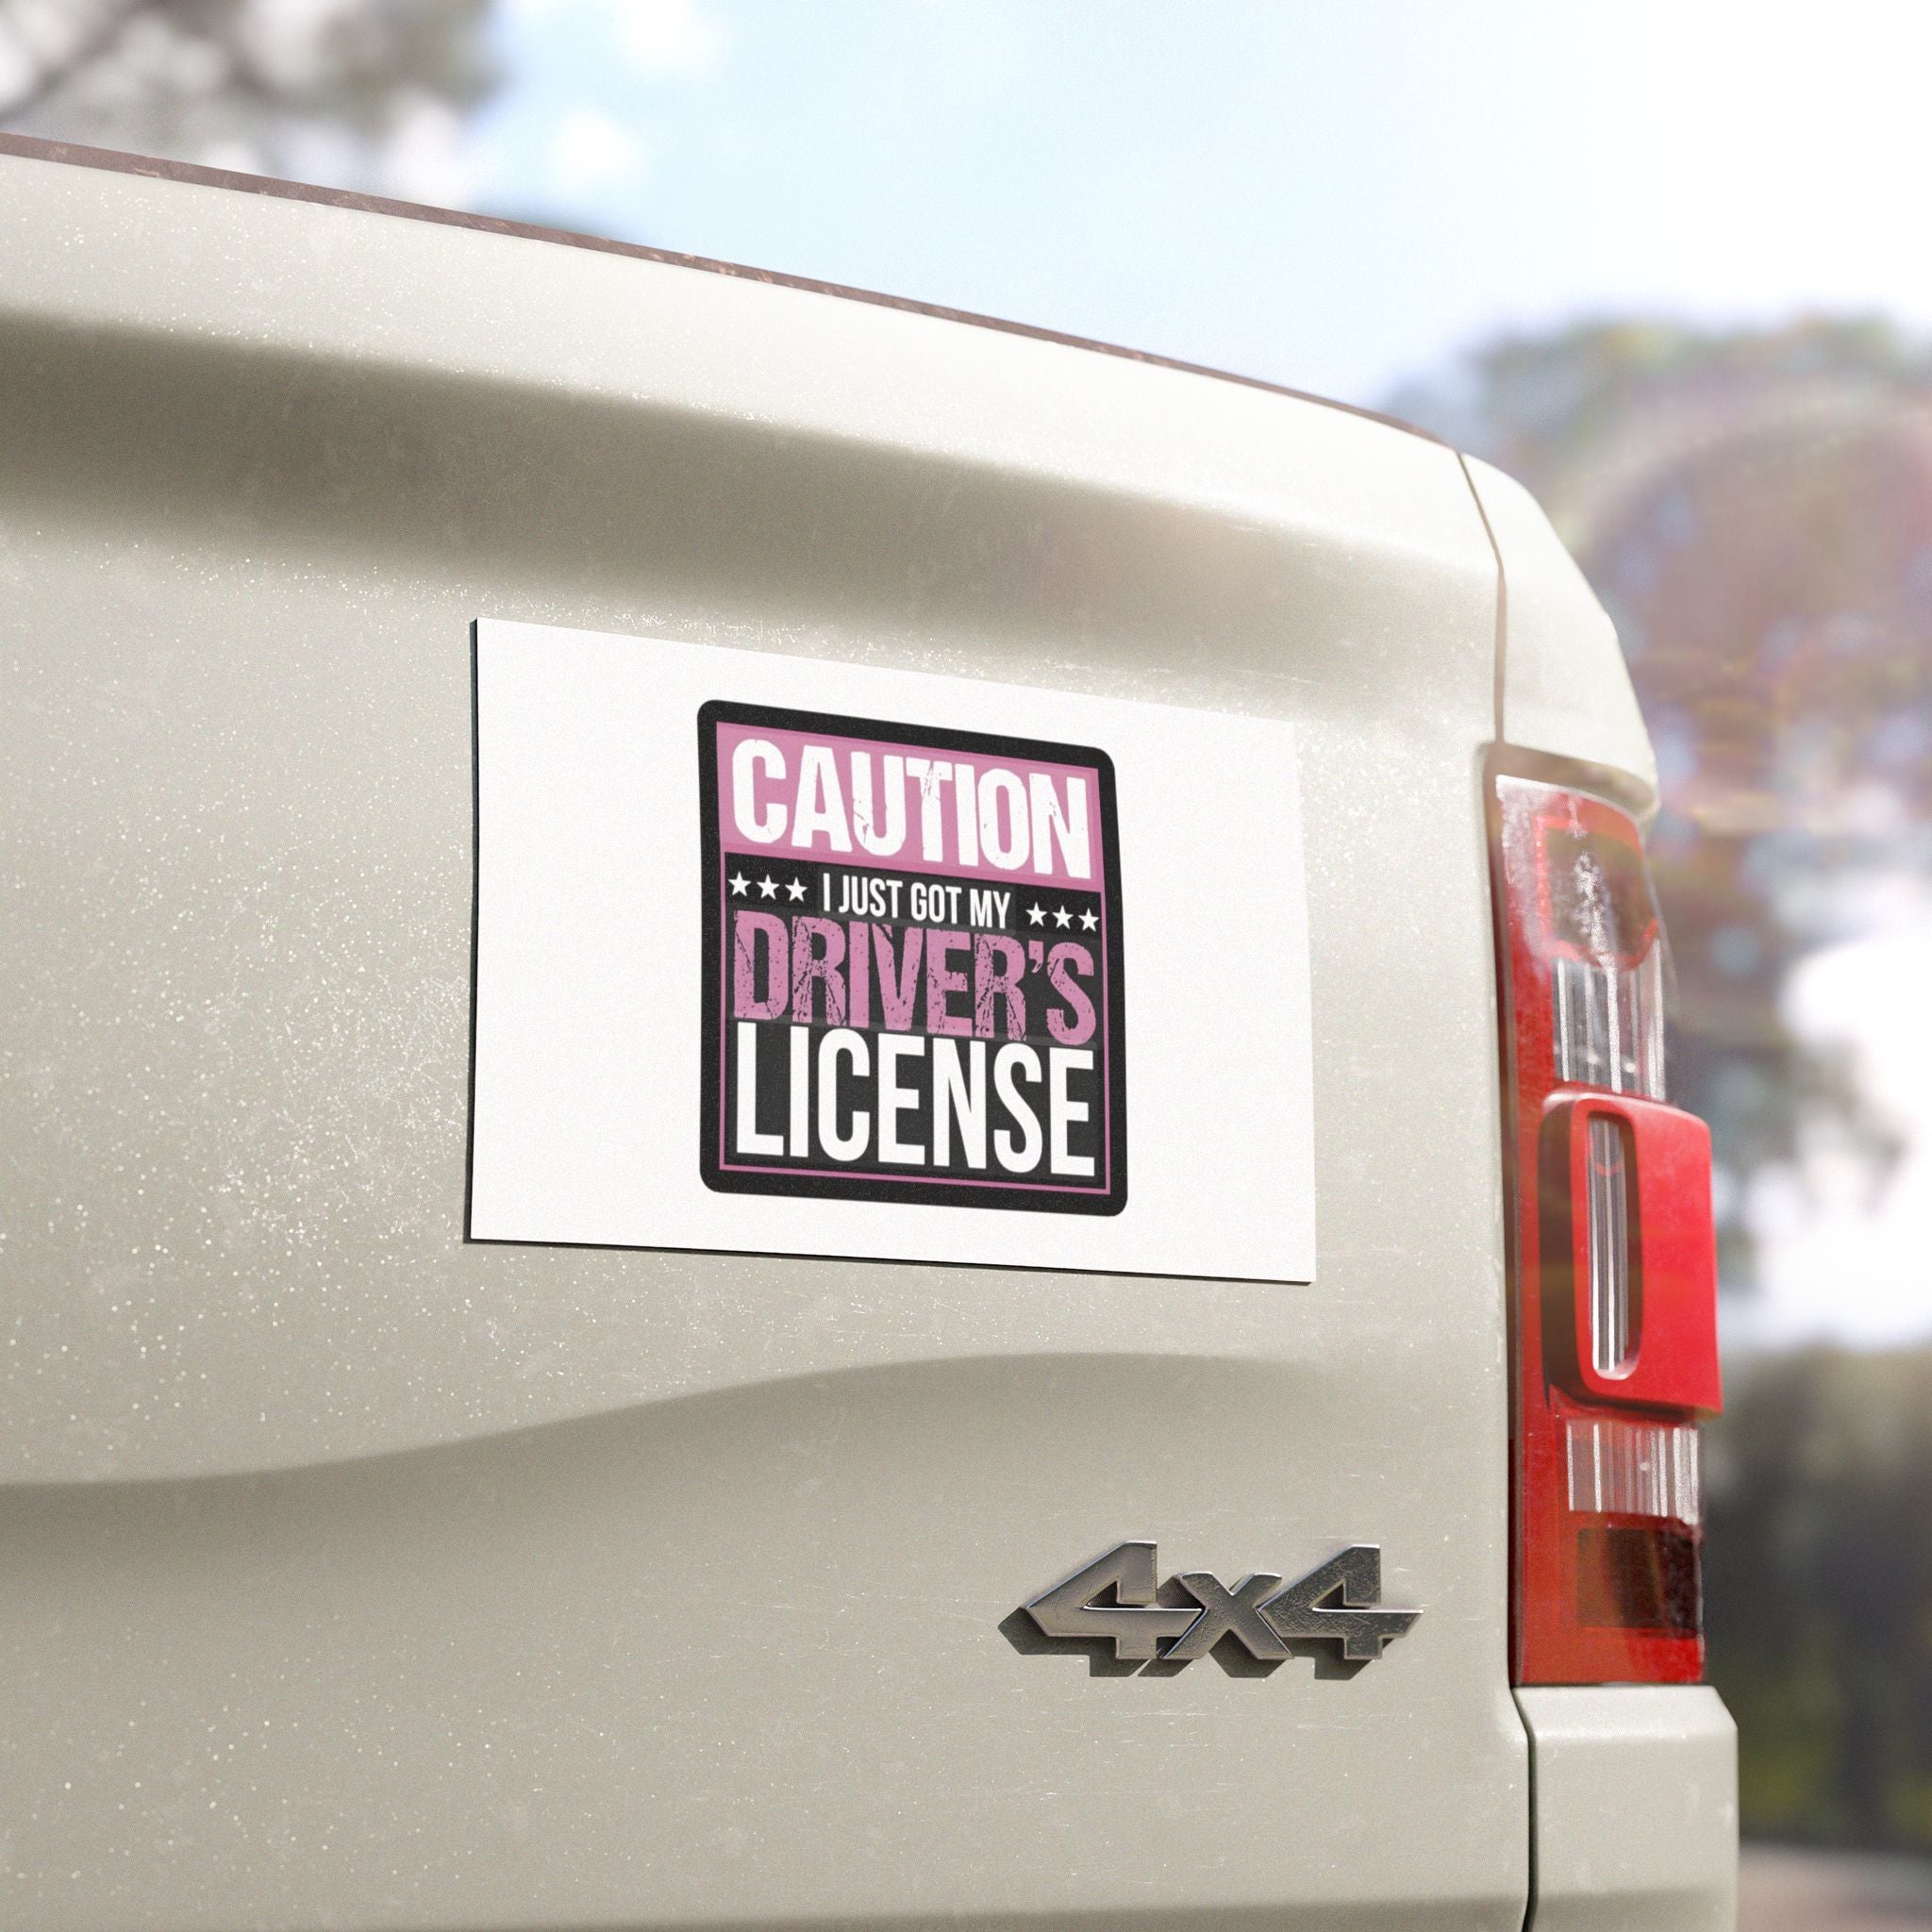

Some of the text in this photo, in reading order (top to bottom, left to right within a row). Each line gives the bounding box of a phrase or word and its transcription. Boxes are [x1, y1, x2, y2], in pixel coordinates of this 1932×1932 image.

[731, 739, 1091, 879] CAUTION
[823, 873, 1011, 929] I JUST GOT MY
[733, 908, 1097, 1046] DRIVER'S
[736, 1020, 1096, 1178] LICENSE
